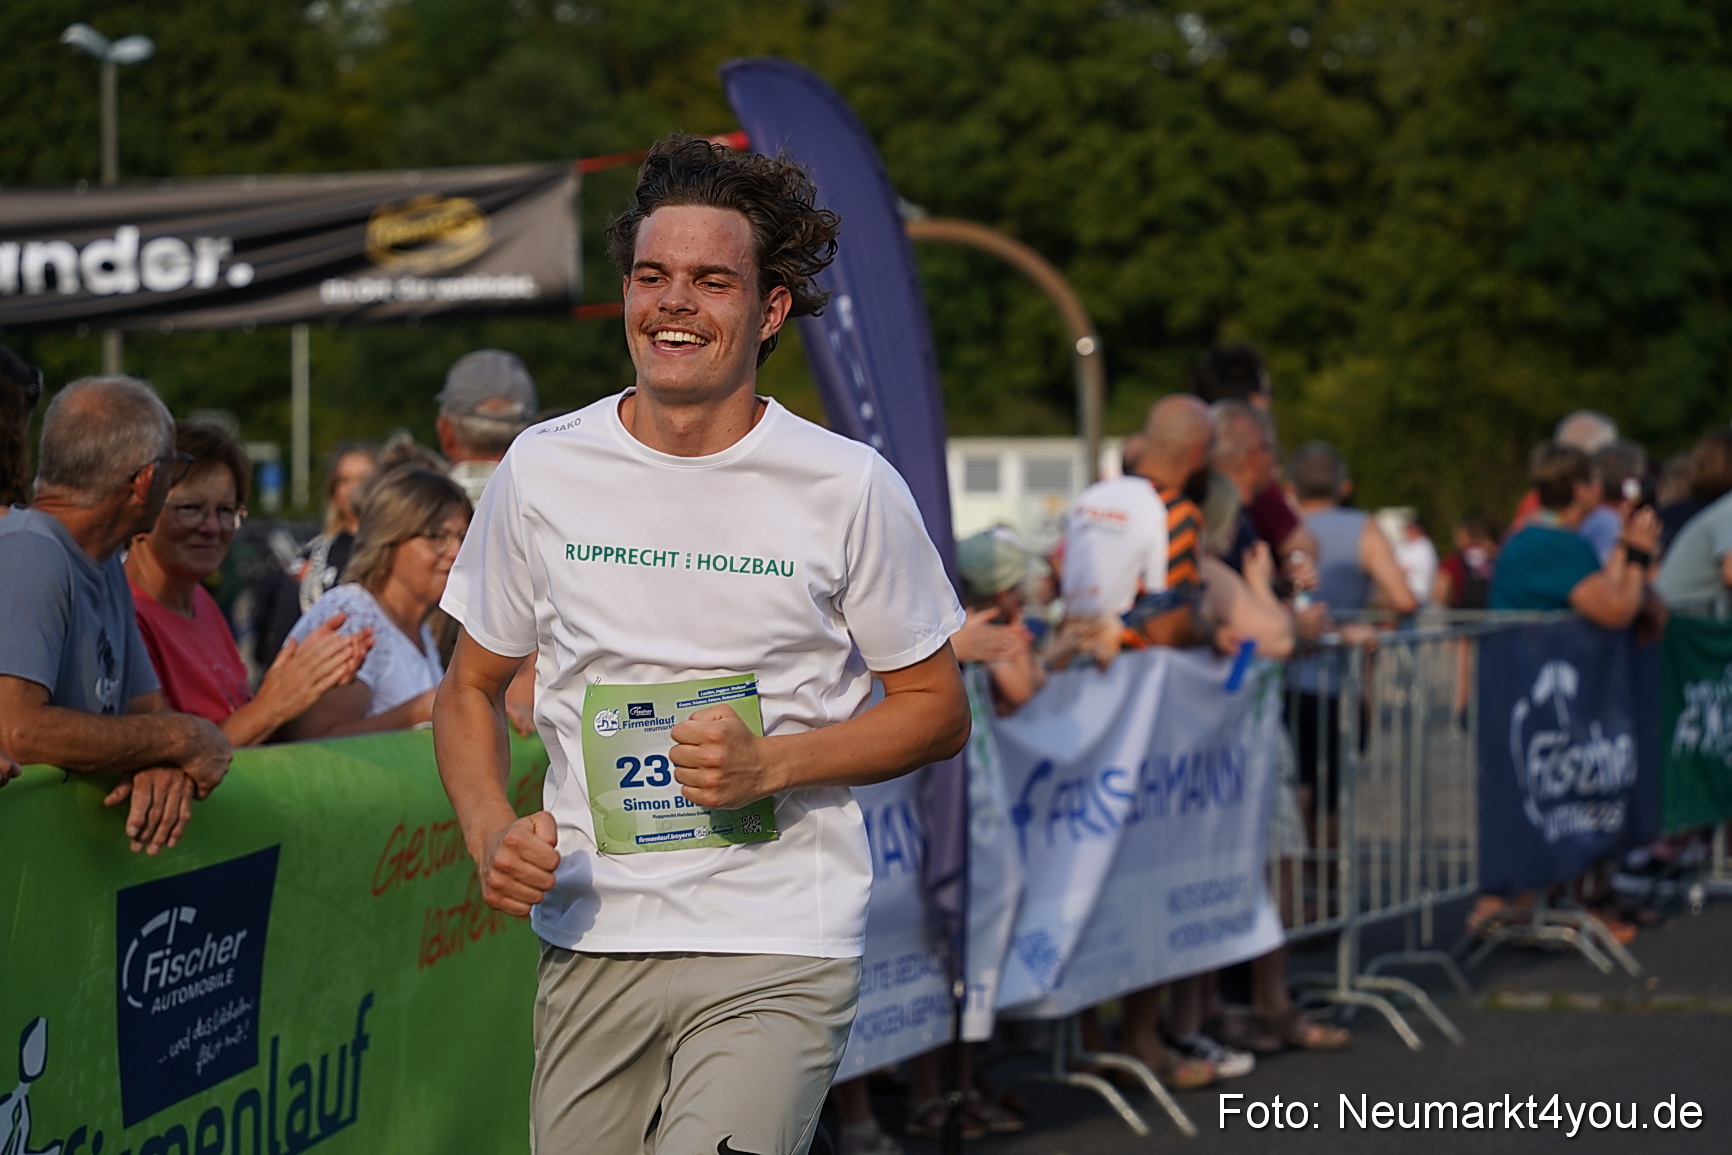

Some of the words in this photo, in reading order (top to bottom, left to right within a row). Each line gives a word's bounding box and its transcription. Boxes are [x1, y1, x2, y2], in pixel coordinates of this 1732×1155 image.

[553, 417, 583, 433] JAKO
[565, 543, 680, 569] RUPPRECHT
[696, 553, 795, 578] HOLZBAU
[622, 715, 675, 730] Firmenlauf
[616, 754, 684, 789] 23
[622, 797, 671, 812] Simon
[674, 796, 702, 810] Bu
[652, 812, 677, 820] Rupprecht
[676, 810, 697, 818] Holzbau
[638, 831, 693, 845] firmenlauf.bayern
[143, 928, 248, 994] Fischer
[151, 967, 236, 1016] AUTOMOBILE
